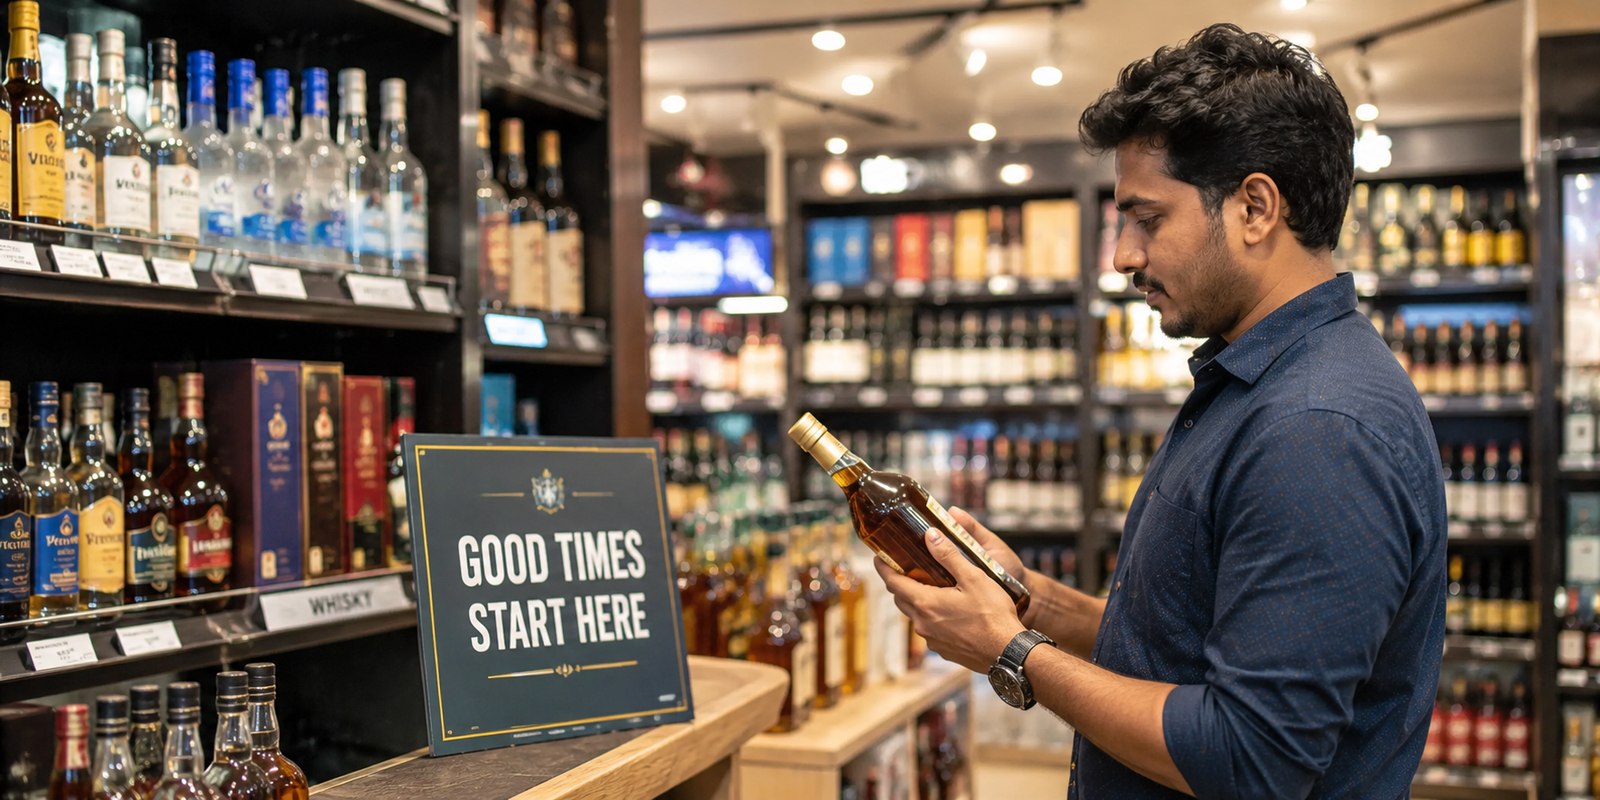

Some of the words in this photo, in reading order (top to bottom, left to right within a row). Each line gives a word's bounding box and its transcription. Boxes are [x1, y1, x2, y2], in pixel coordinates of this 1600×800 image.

[458, 533, 549, 587] GOOD
[554, 529, 646, 582] TIMES
[309, 590, 373, 616] WHISKY
[468, 597, 566, 653] START
[574, 592, 650, 644] HERE
